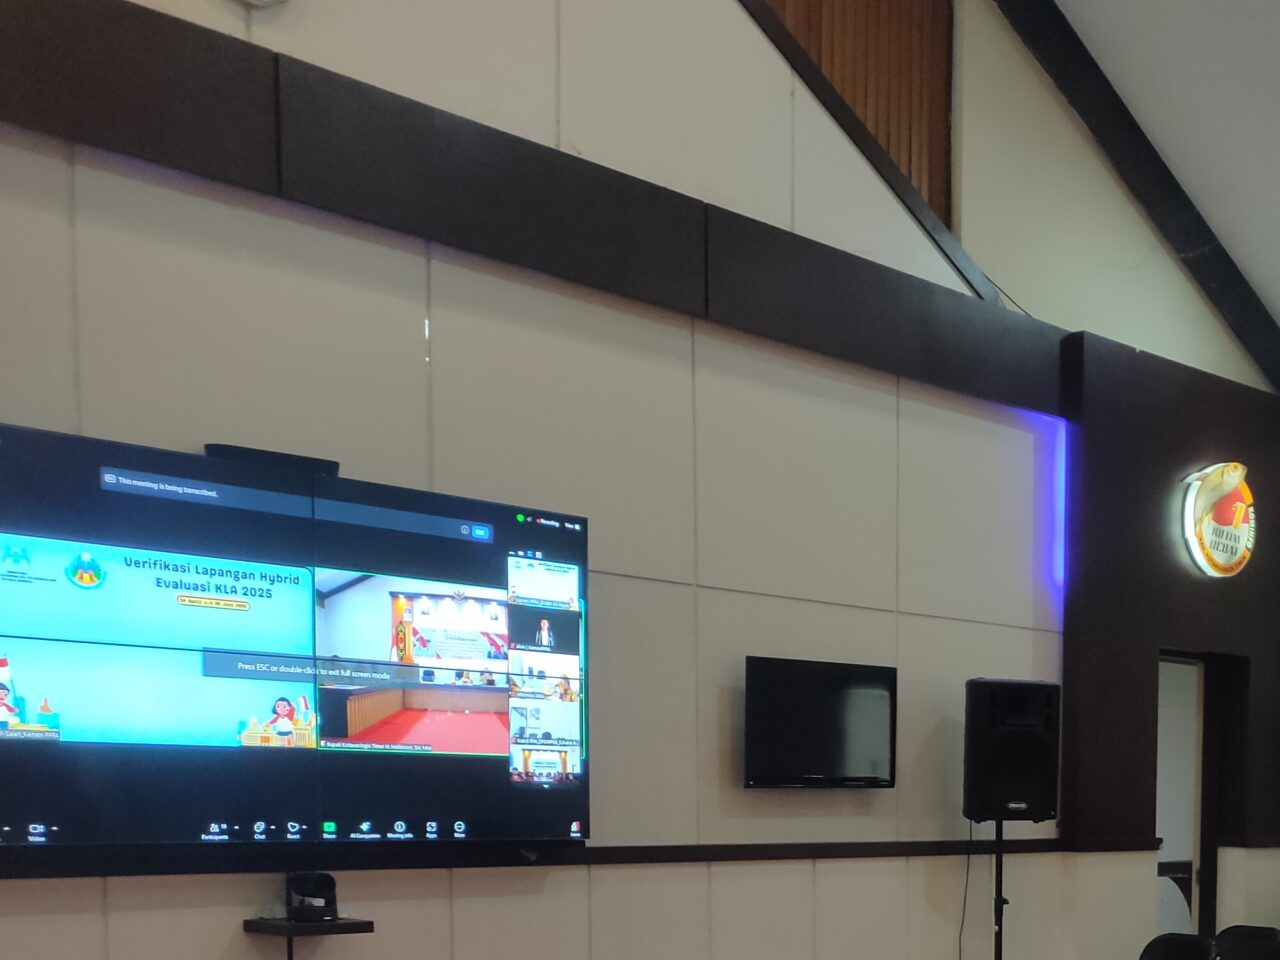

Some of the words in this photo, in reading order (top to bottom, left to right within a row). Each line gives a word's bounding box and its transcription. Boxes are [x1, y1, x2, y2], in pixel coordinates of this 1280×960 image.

[118, 476, 131, 485] This
[132, 479, 158, 490] meeting
[165, 484, 183, 493] being
[124, 556, 191, 573] Verifikasi
[195, 565, 256, 582] Lapangan
[260, 571, 300, 585] Hybrid
[156, 577, 211, 592] Evaluasi
[215, 583, 237, 595] KLA
[241, 586, 273, 599] 2025
[238, 662, 255, 670] Press
[256, 664, 270, 672] ESC
[279, 665, 319, 675] double-click
[328, 669, 341, 677] exit
[341, 668, 350, 677] full
[371, 671, 390, 680] mode
